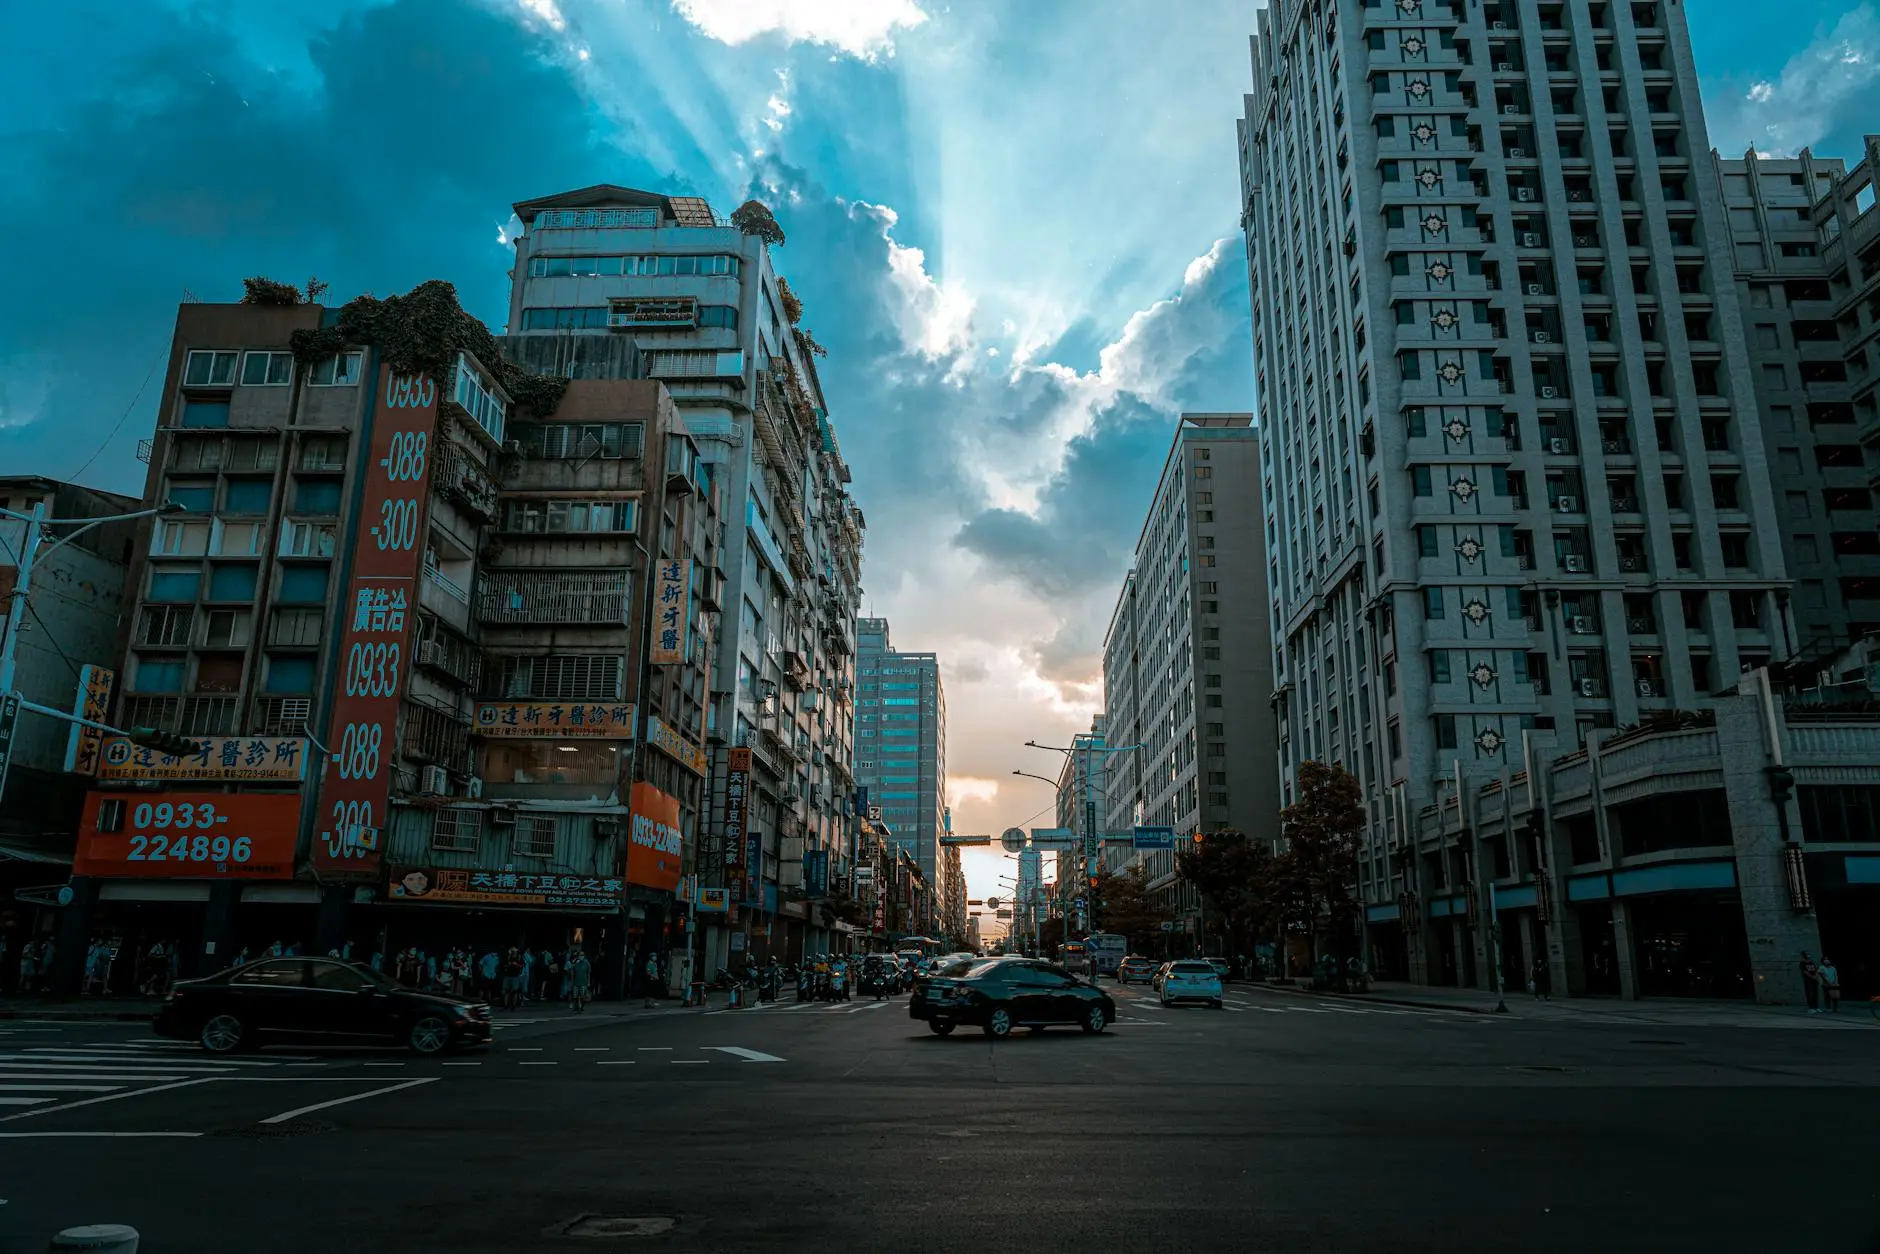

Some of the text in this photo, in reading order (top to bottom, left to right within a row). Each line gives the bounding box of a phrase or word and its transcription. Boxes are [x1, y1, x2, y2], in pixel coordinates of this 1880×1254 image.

[380, 431, 426, 481] -088
[371, 499, 417, 551] -300
[352, 587, 407, 632] 廣告洽
[659, 562, 682, 650] 達新牙醫
[346, 642, 400, 697] 0933
[502, 705, 630, 726] 達新牙醫診所
[332, 722, 381, 780] -088
[134, 801, 228, 829] 0933-
[127, 835, 252, 862] 224896
